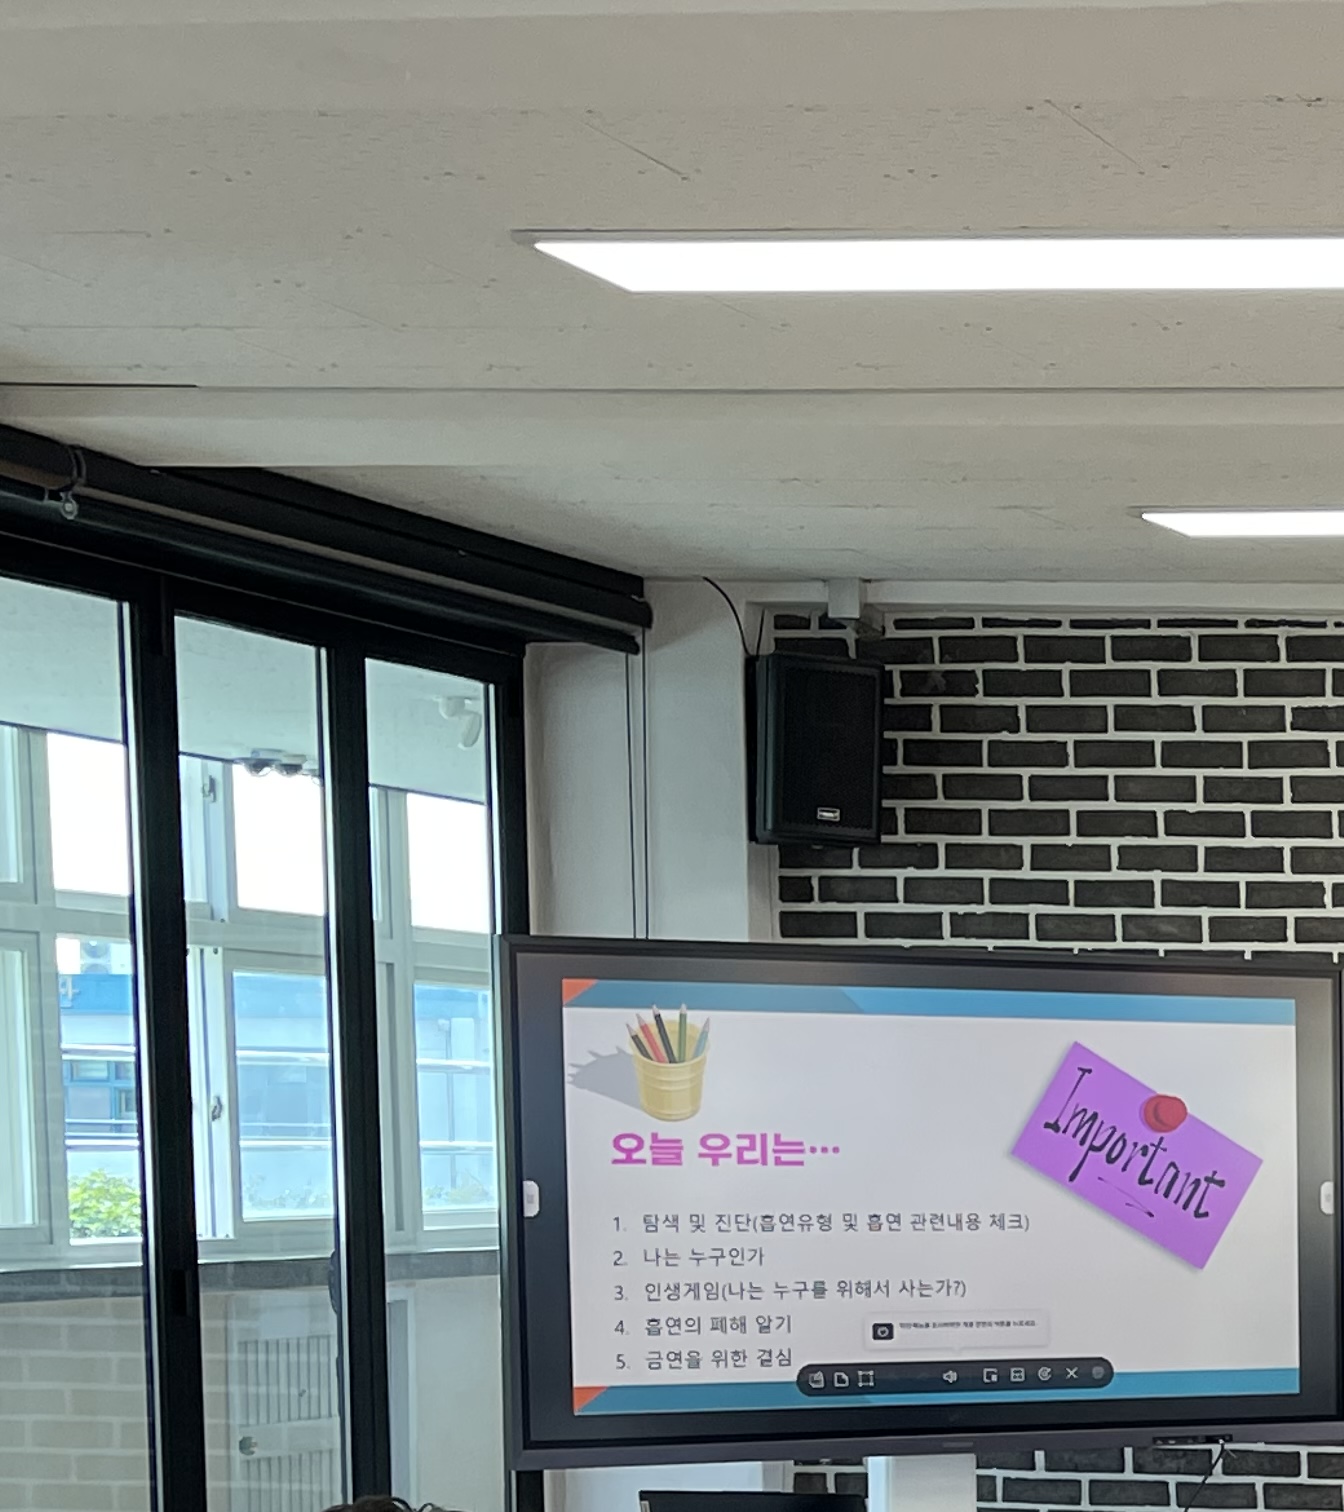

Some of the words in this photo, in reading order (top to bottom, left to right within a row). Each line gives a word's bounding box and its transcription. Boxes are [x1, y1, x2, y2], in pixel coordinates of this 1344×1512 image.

[611, 1132, 684, 1166] 오늘
[1042, 1066, 1226, 1219] Important
[643, 1213, 680, 1234] 탐색
[690, 1213, 706, 1233] 및
[715, 1213, 833, 1233] 진단(흡연유형
[842, 1213, 858, 1232] 및
[867, 1212, 902, 1232] 흡연
[910, 1212, 981, 1232] 관련내용
[989, 1212, 1030, 1232] 체크)
[643, 1247, 681, 1267] 나는
[688, 1246, 765, 1267] 누구인가
[645, 1281, 765, 1302] 인생게임(나는
[773, 1281, 828, 1300] 누구를
[836, 1279, 891, 1299] 위해서
[898, 1278, 968, 1298] 사는가?)
[645, 1316, 701, 1336] 흡연의
[755, 1314, 792, 1335] 알기
[645, 1350, 702, 1370] 금연을
[711, 1349, 747, 1369] 위한
[756, 1347, 792, 1367] 결심
